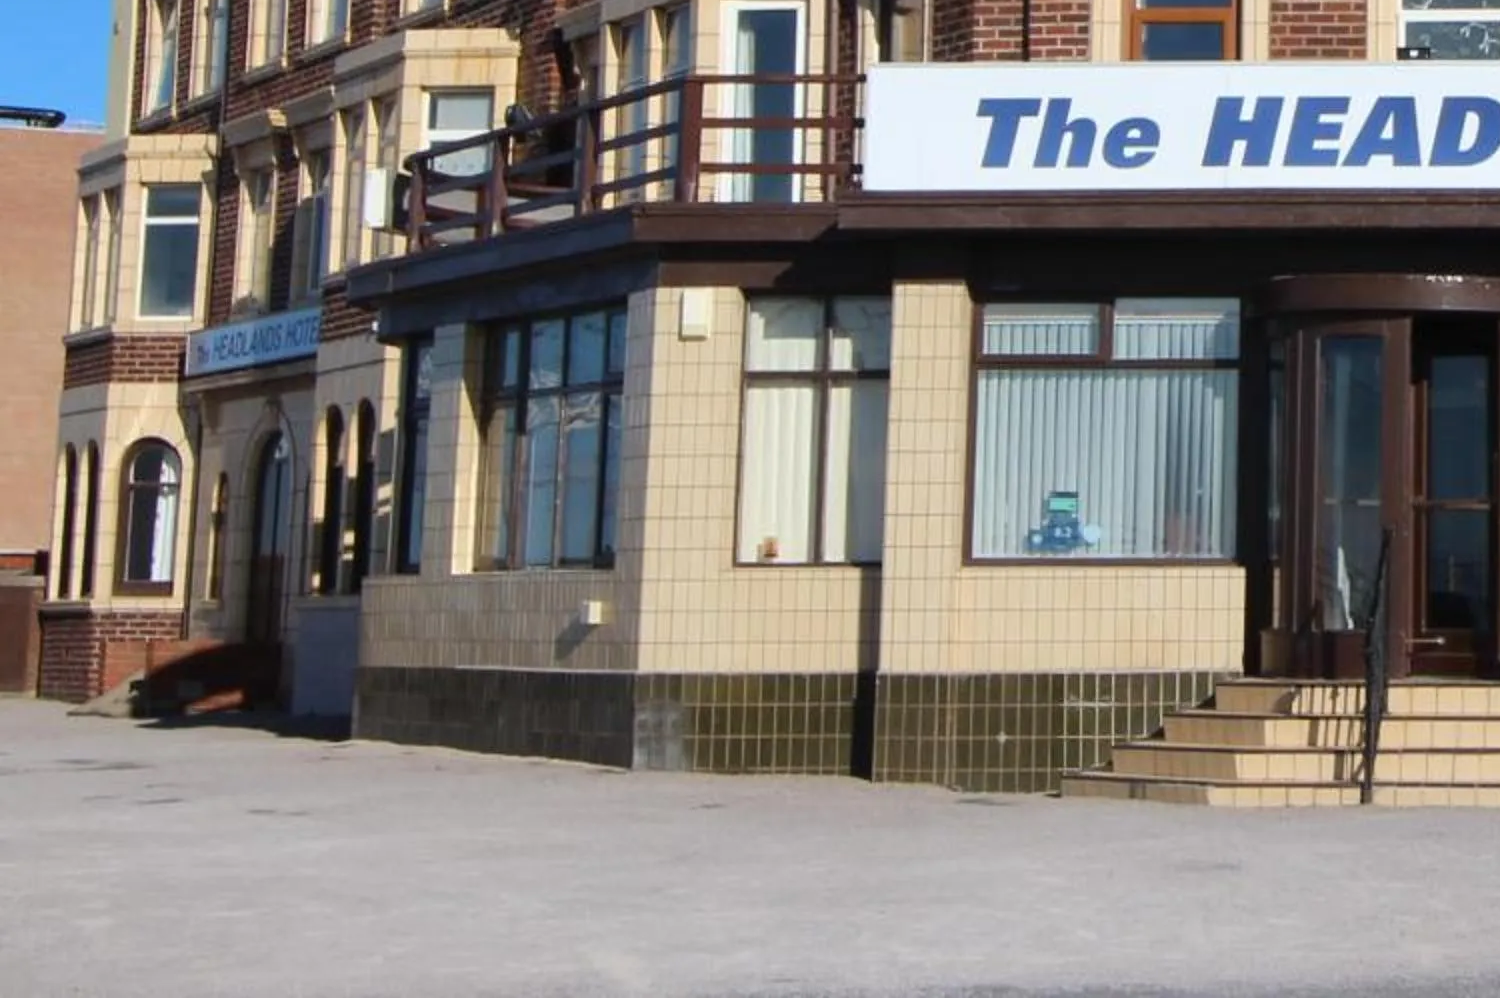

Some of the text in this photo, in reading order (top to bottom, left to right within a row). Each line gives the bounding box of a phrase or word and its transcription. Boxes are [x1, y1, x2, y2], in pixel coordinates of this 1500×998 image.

[975, 97, 1161, 169] The
[212, 323, 282, 362] HEADLANDS
[285, 315, 321, 349] HOTE
